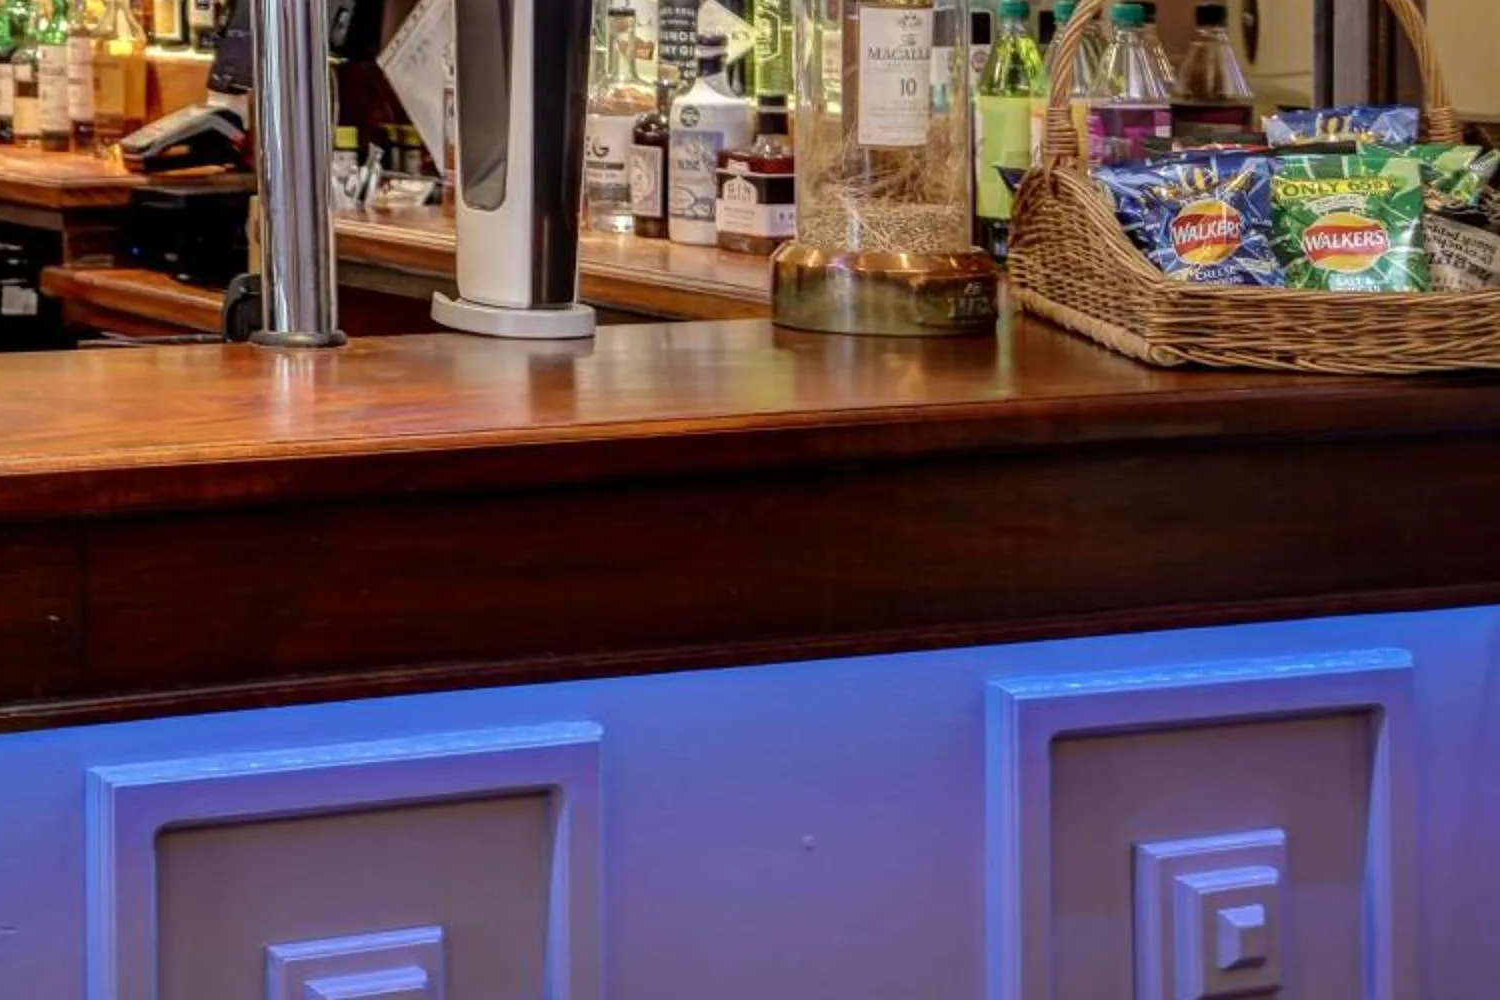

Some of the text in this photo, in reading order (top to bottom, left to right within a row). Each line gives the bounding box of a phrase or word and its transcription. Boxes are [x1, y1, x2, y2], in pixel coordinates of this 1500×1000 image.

[900, 77, 918, 97] 10
[1282, 182, 1338, 197] ONLY
[1172, 220, 1241, 243] WALKERS
[1305, 230, 1386, 251] WALKERS
